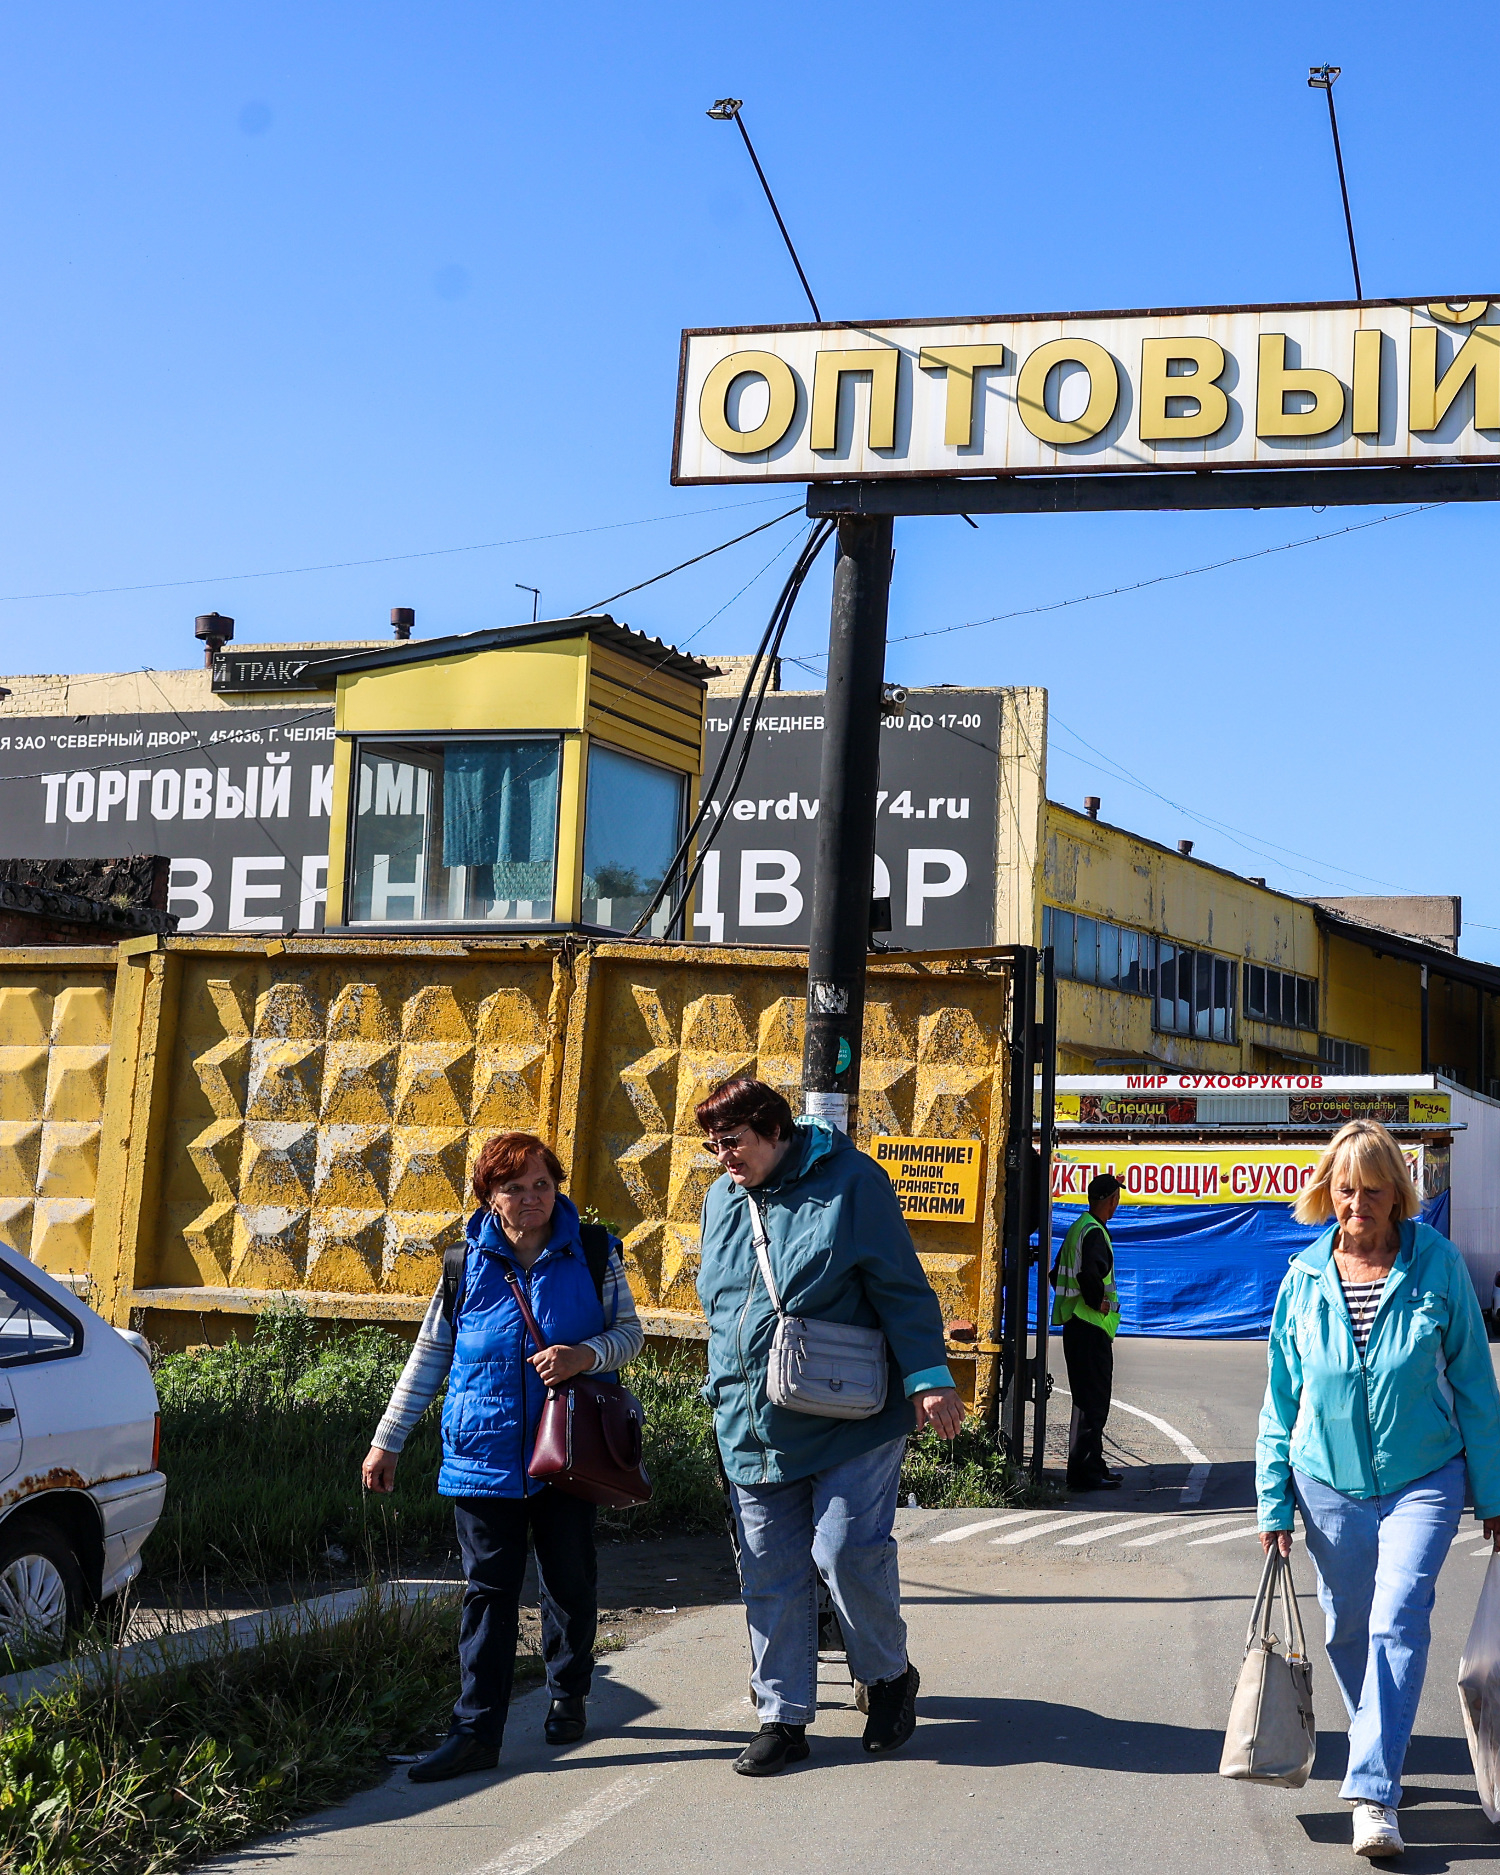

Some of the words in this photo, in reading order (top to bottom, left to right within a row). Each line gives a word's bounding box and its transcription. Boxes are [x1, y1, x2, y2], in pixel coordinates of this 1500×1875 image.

[14, 736, 46, 750] ЗАО
[50, 730, 143, 749] "СЕВЕРНЫЙ
[147, 730, 201, 748] ДВОР",
[268, 728, 280, 742] Г.
[908, 714, 934, 732] ДО
[938, 714, 982, 729] 17-00
[41, 751, 292, 823] ТОРГОВЫЙ
[1126, 1075, 1168, 1089] МИР
[1179, 1074, 1323, 1089] СУХОФРУКТОВ
[1105, 1100, 1165, 1115] Специи
[1303, 1100, 1350, 1111] Готовые
[1353, 1100, 1397, 1111] салаты
[1414, 1098, 1447, 1114] Посуда
[877, 1143, 973, 1164] ВНИМАНИЕ!
[901, 1163, 945, 1179] РЫНОК
[890, 1178, 960, 1196] ХРАНЯЕТСЯ
[1127, 1164, 1218, 1197] ОВОЩИ
[897, 1194, 966, 1215] БАКАМИ
